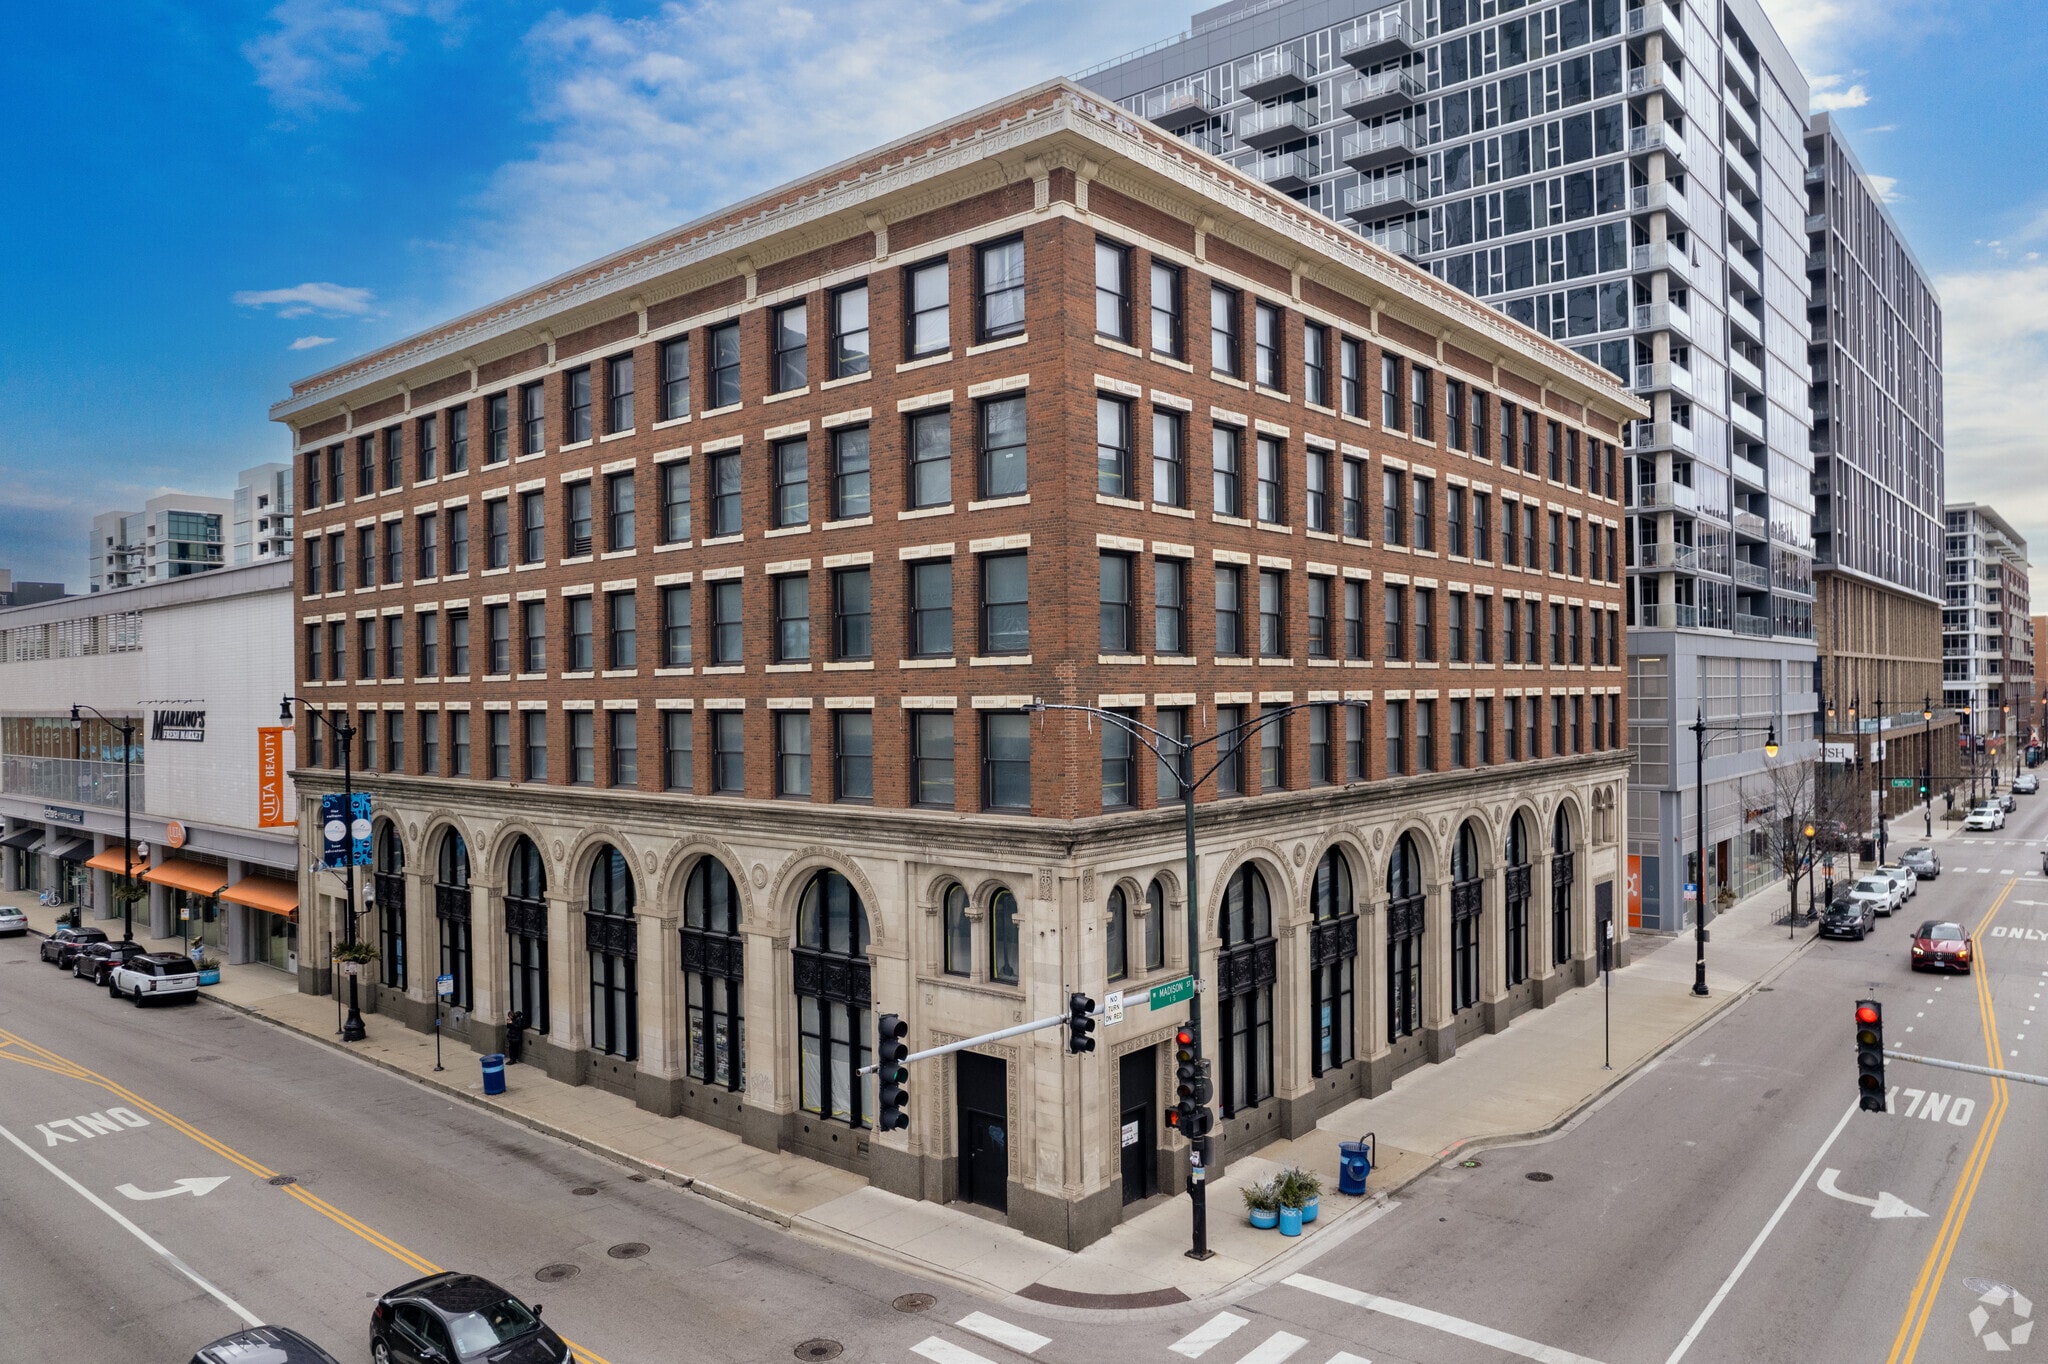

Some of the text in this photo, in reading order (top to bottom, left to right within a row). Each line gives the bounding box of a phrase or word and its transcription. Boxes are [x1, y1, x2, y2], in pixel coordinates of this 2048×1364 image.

[151, 709, 206, 741] MARIANO'S
[263, 733, 278, 820] ULTA BEAUTY
[1990, 926, 2048, 941] ONLY
[1159, 983, 1184, 998] MADISON
[1110, 995, 1117, 1003] NO
[1108, 1004, 1120, 1012] TURN
[34, 1107, 151, 1147] ONLY
